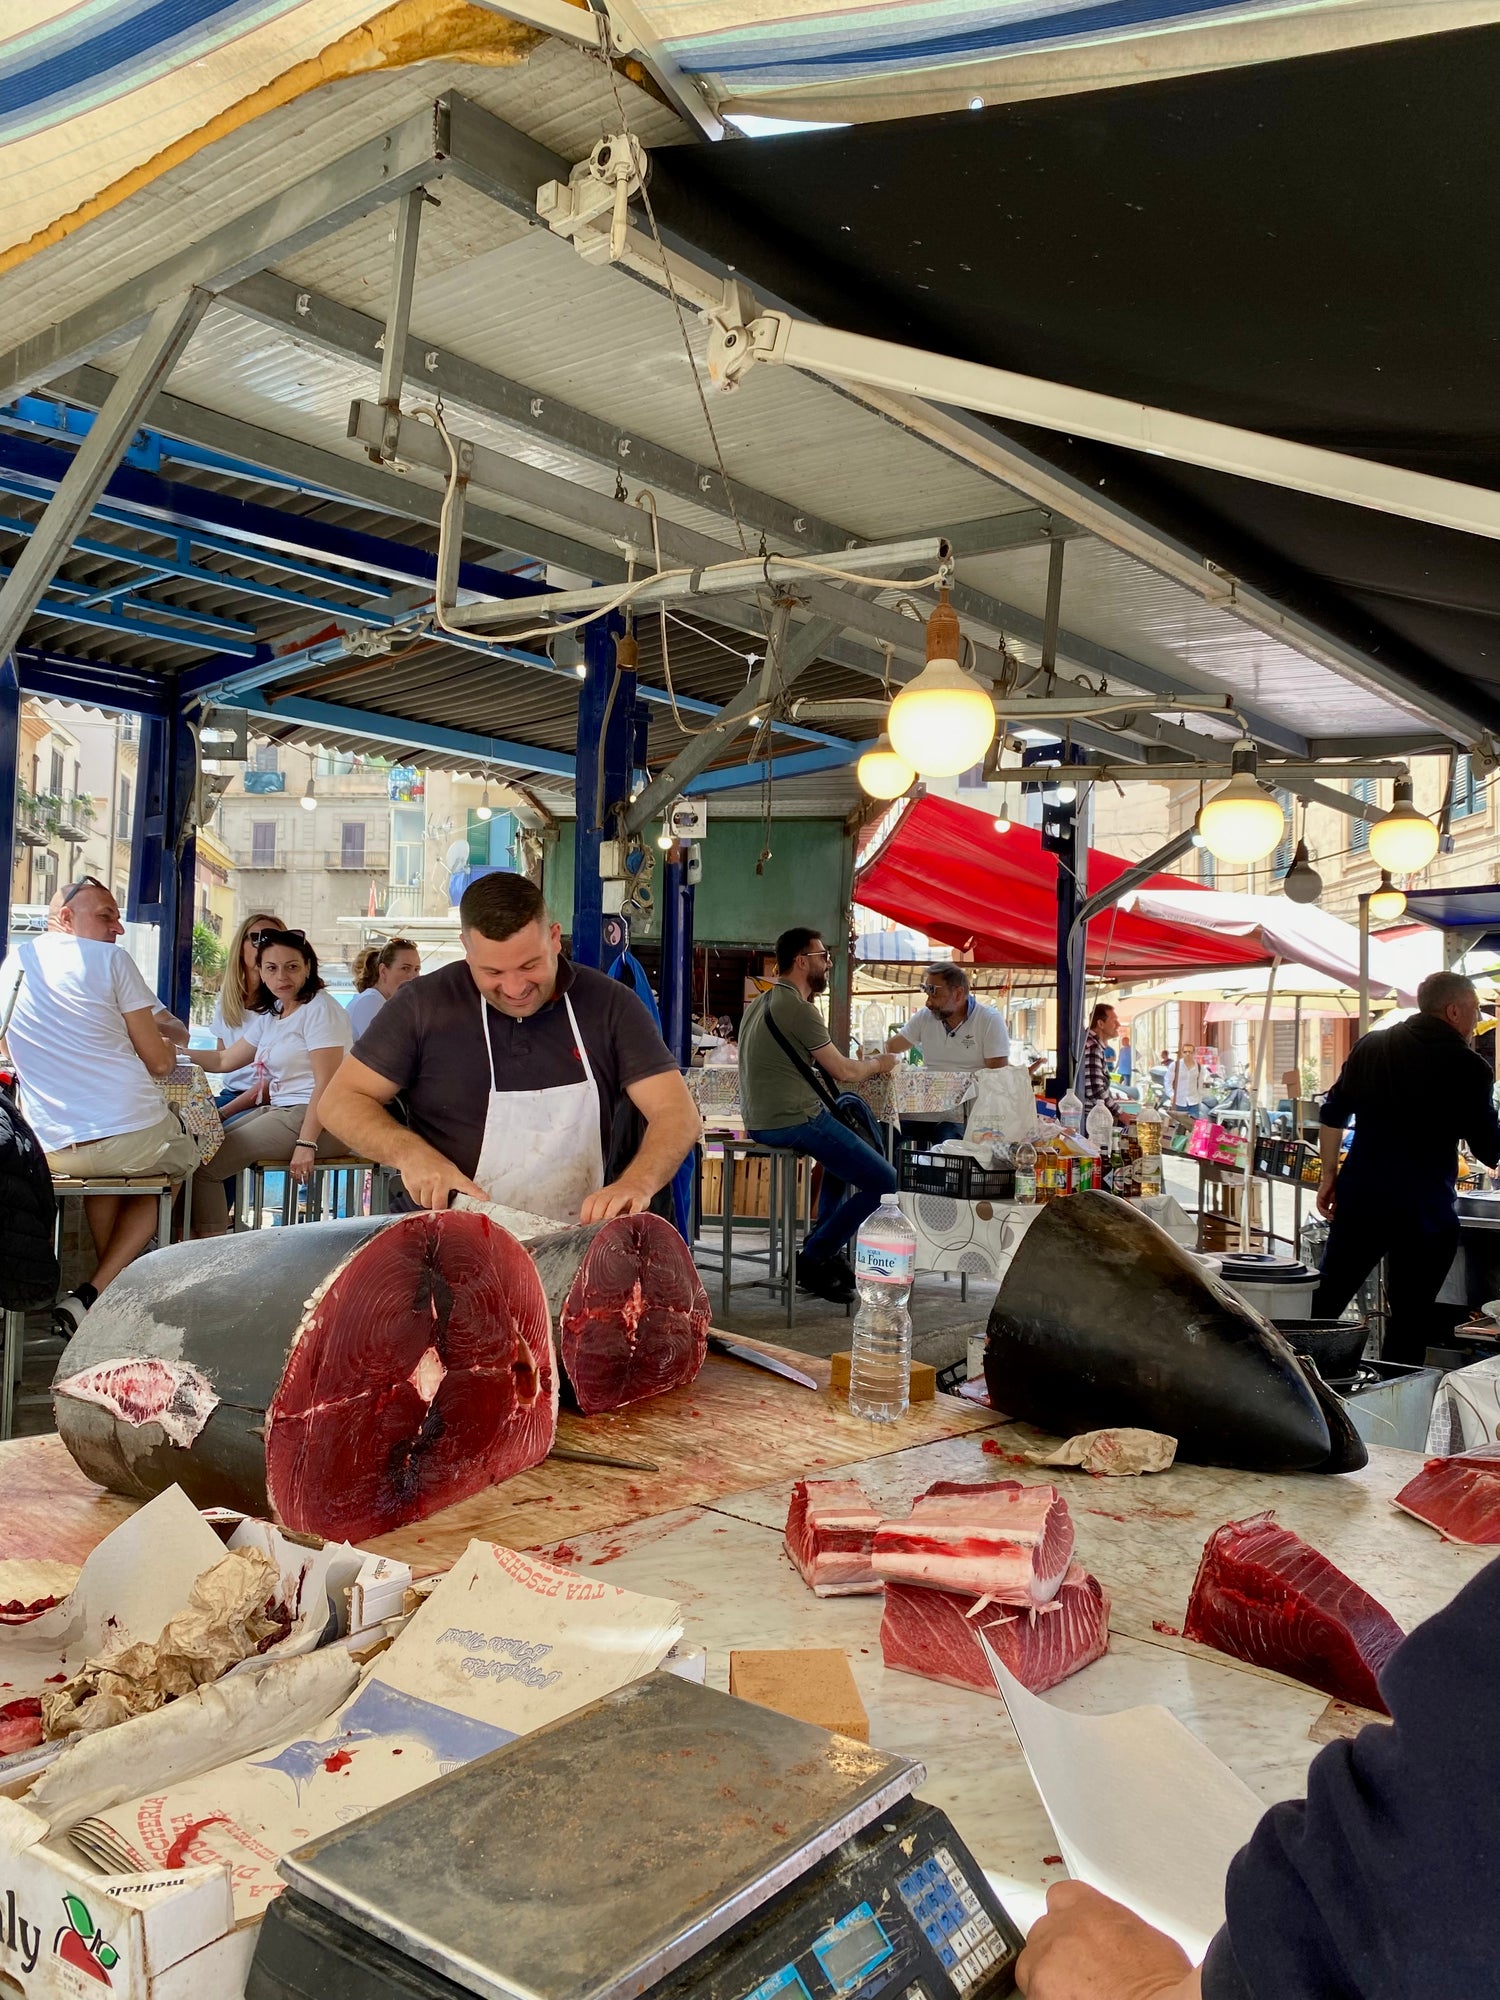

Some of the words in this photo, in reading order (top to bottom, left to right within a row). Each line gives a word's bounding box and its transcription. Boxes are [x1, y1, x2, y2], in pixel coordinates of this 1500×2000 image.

[857, 1252, 866, 1264] La
[868, 1254, 895, 1268] Fonte
[566, 1583, 605, 1600] TUA
[137, 1796, 171, 1869] SCHERIA
[903, 1882, 911, 1892] 7
[916, 1872, 927, 1885] 8
[928, 1863, 938, 1874] 9
[941, 1854, 949, 1866] C
[106, 1878, 185, 1897] melitaly
[918, 1904, 929, 1918] 4
[929, 1893, 939, 1908] 5
[941, 1884, 952, 1897] 6
[951, 1875, 963, 1888] M+
[941, 1914, 953, 1930] 2
[954, 1902, 965, 1919] 3
[966, 1926, 977, 1938] M
[953, 1970, 965, 1980] M
[966, 1958, 977, 1969] M
[978, 1947, 988, 1956] M
[760, 1976, 783, 1997] PRICE
